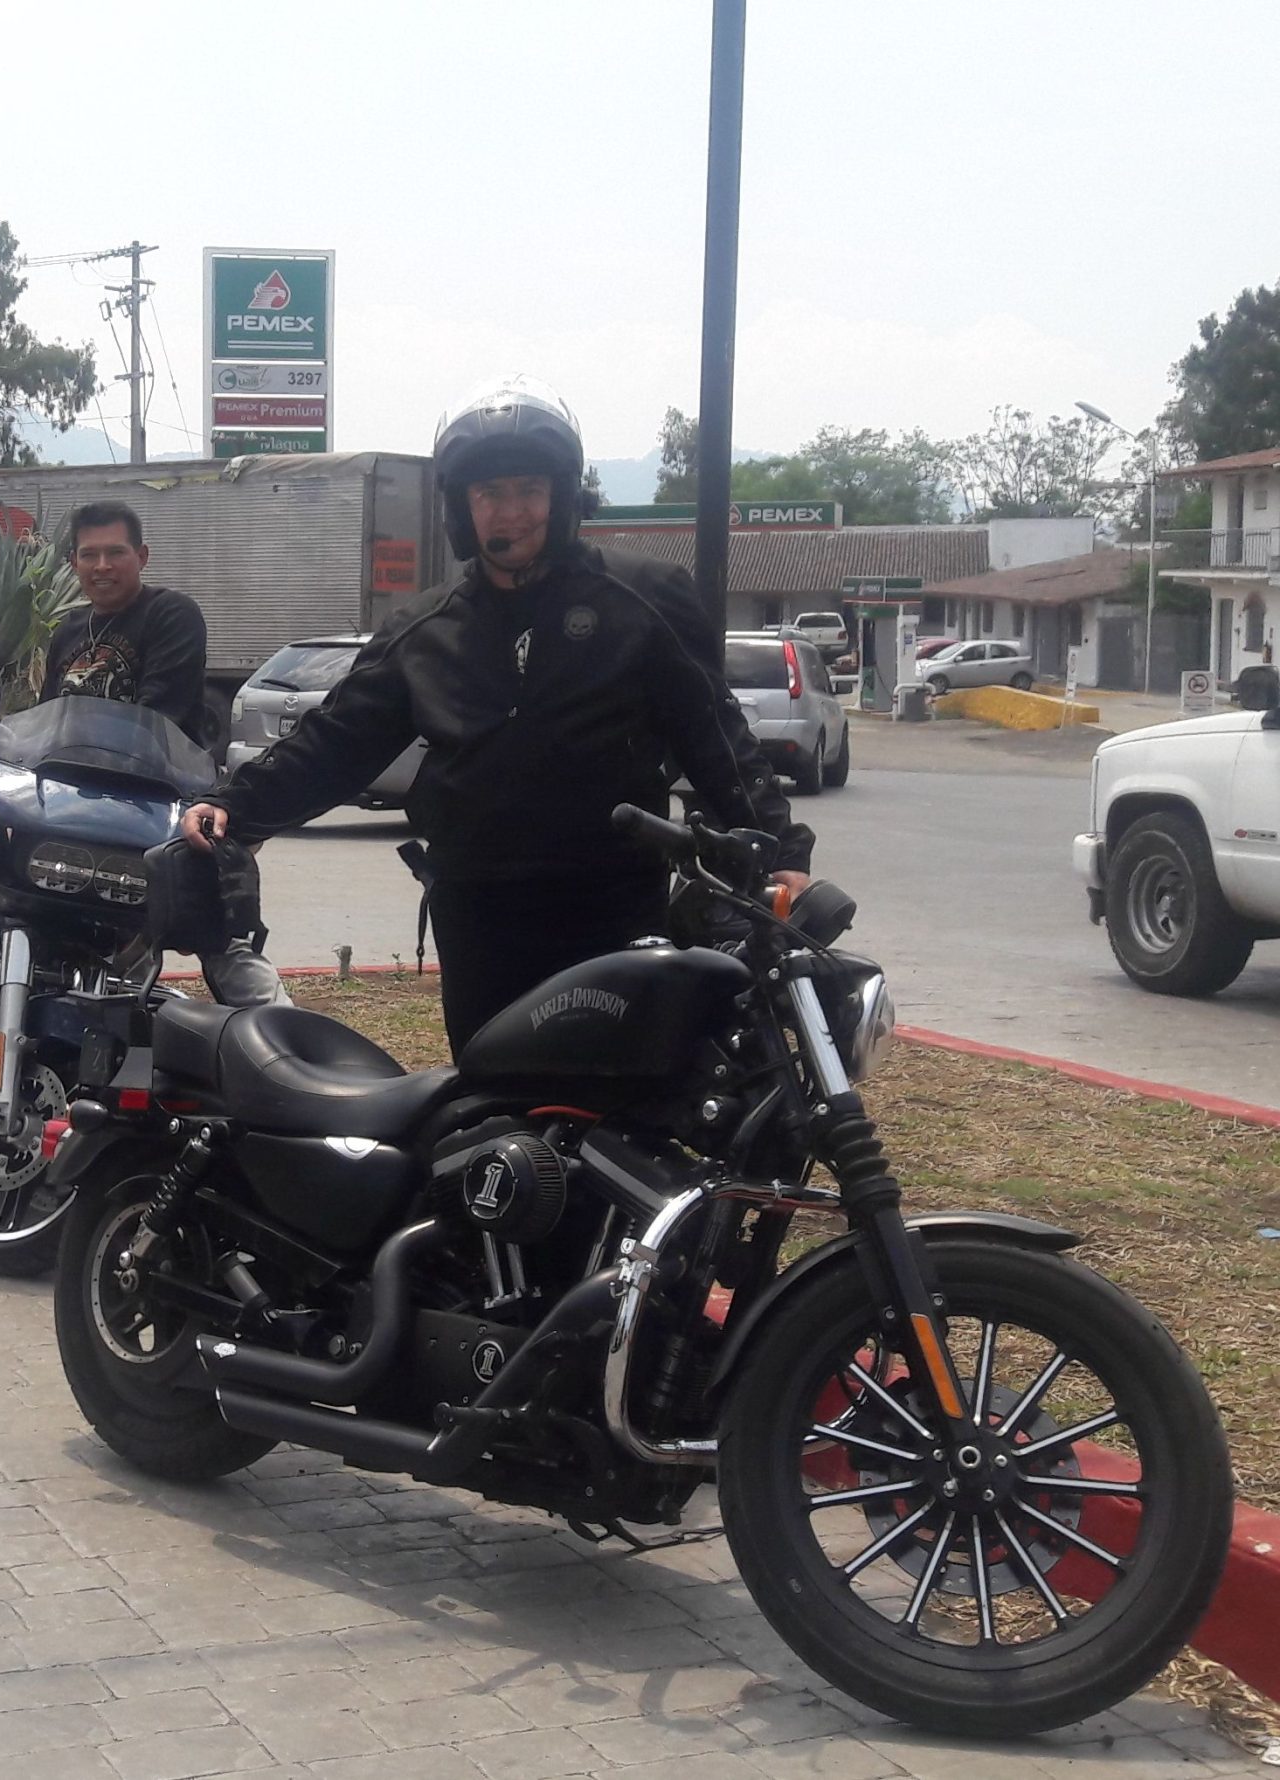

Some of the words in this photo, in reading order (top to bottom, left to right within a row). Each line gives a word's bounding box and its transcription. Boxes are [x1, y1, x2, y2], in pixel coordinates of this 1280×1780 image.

[227, 314, 314, 332] PEMEX
[287, 371, 322, 386] 3297
[260, 404, 323, 417] Premium
[260, 437, 310, 453] Magna
[748, 508, 823, 523] PEMEX
[530, 987, 629, 1031] HARLEY-DAVIDSON
